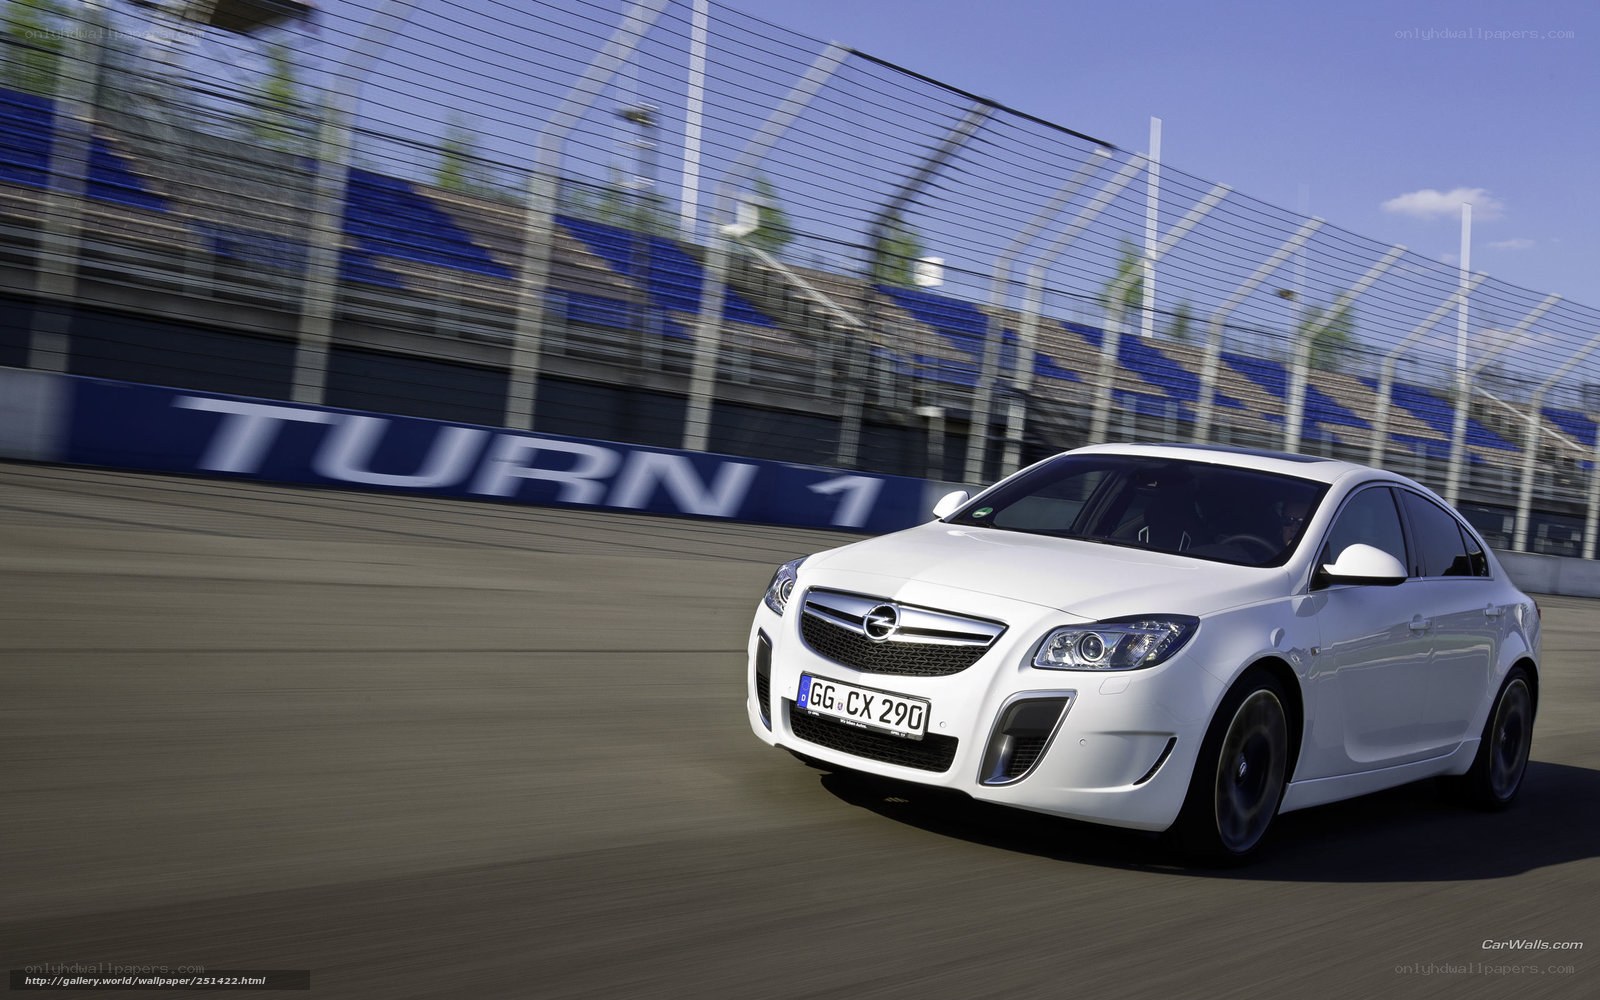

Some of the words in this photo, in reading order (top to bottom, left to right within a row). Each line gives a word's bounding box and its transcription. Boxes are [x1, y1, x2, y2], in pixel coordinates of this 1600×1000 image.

[174, 396, 760, 517] TURN
[808, 476, 886, 528] 1
[810, 682, 836, 710] GG
[846, 690, 875, 719] CX
[879, 698, 922, 730] 290
